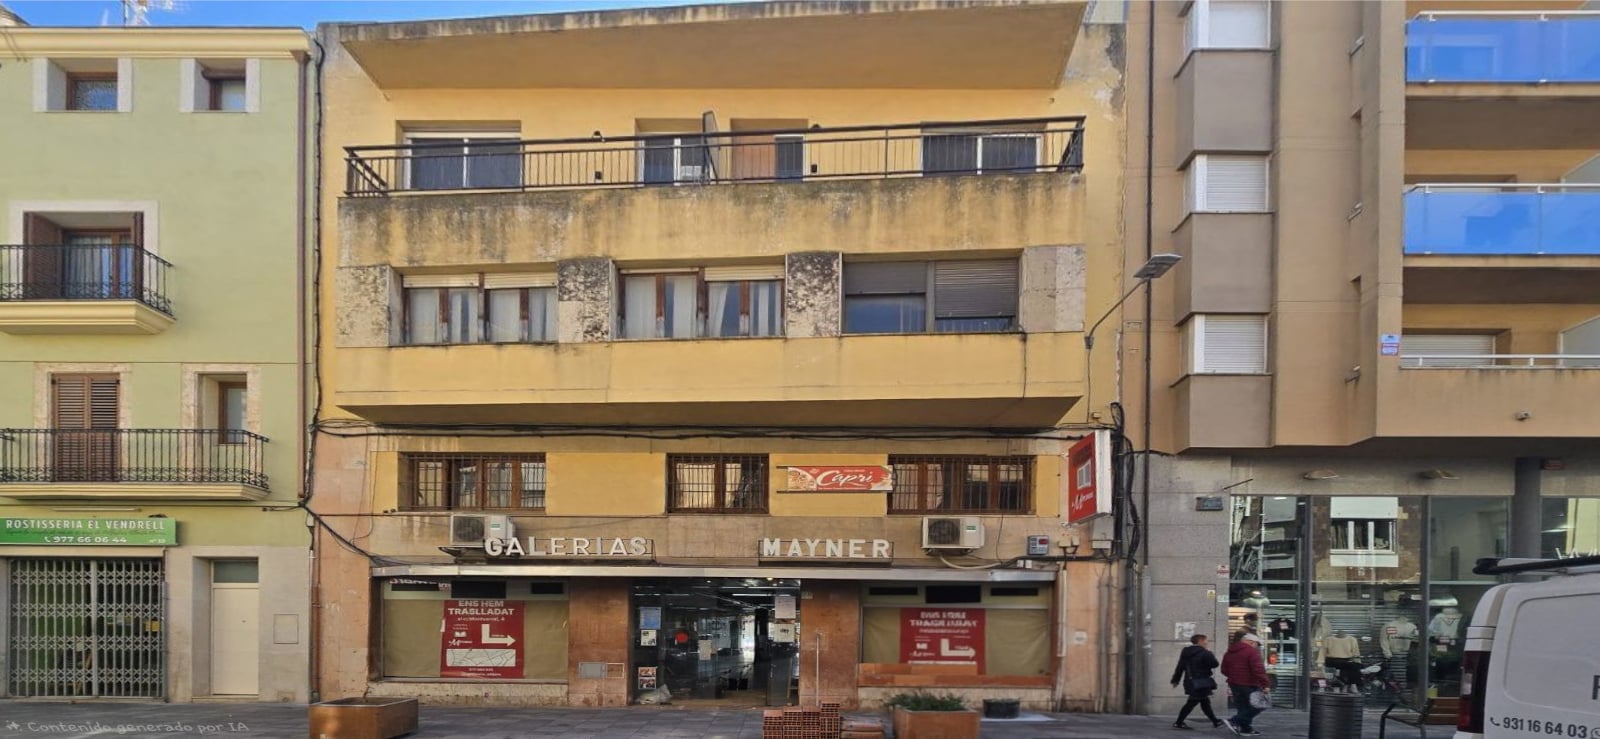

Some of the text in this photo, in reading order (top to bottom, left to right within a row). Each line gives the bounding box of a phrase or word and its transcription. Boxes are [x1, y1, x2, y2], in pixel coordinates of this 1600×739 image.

[816, 470, 873, 487] Capri
[6, 519, 165, 530] ROSTISSERIA EL VENDRELL
[484, 536, 648, 556] GALERIAS
[762, 537, 890, 559] MAYNER
[1503, 717, 1587, 739] 931 16 64 03
